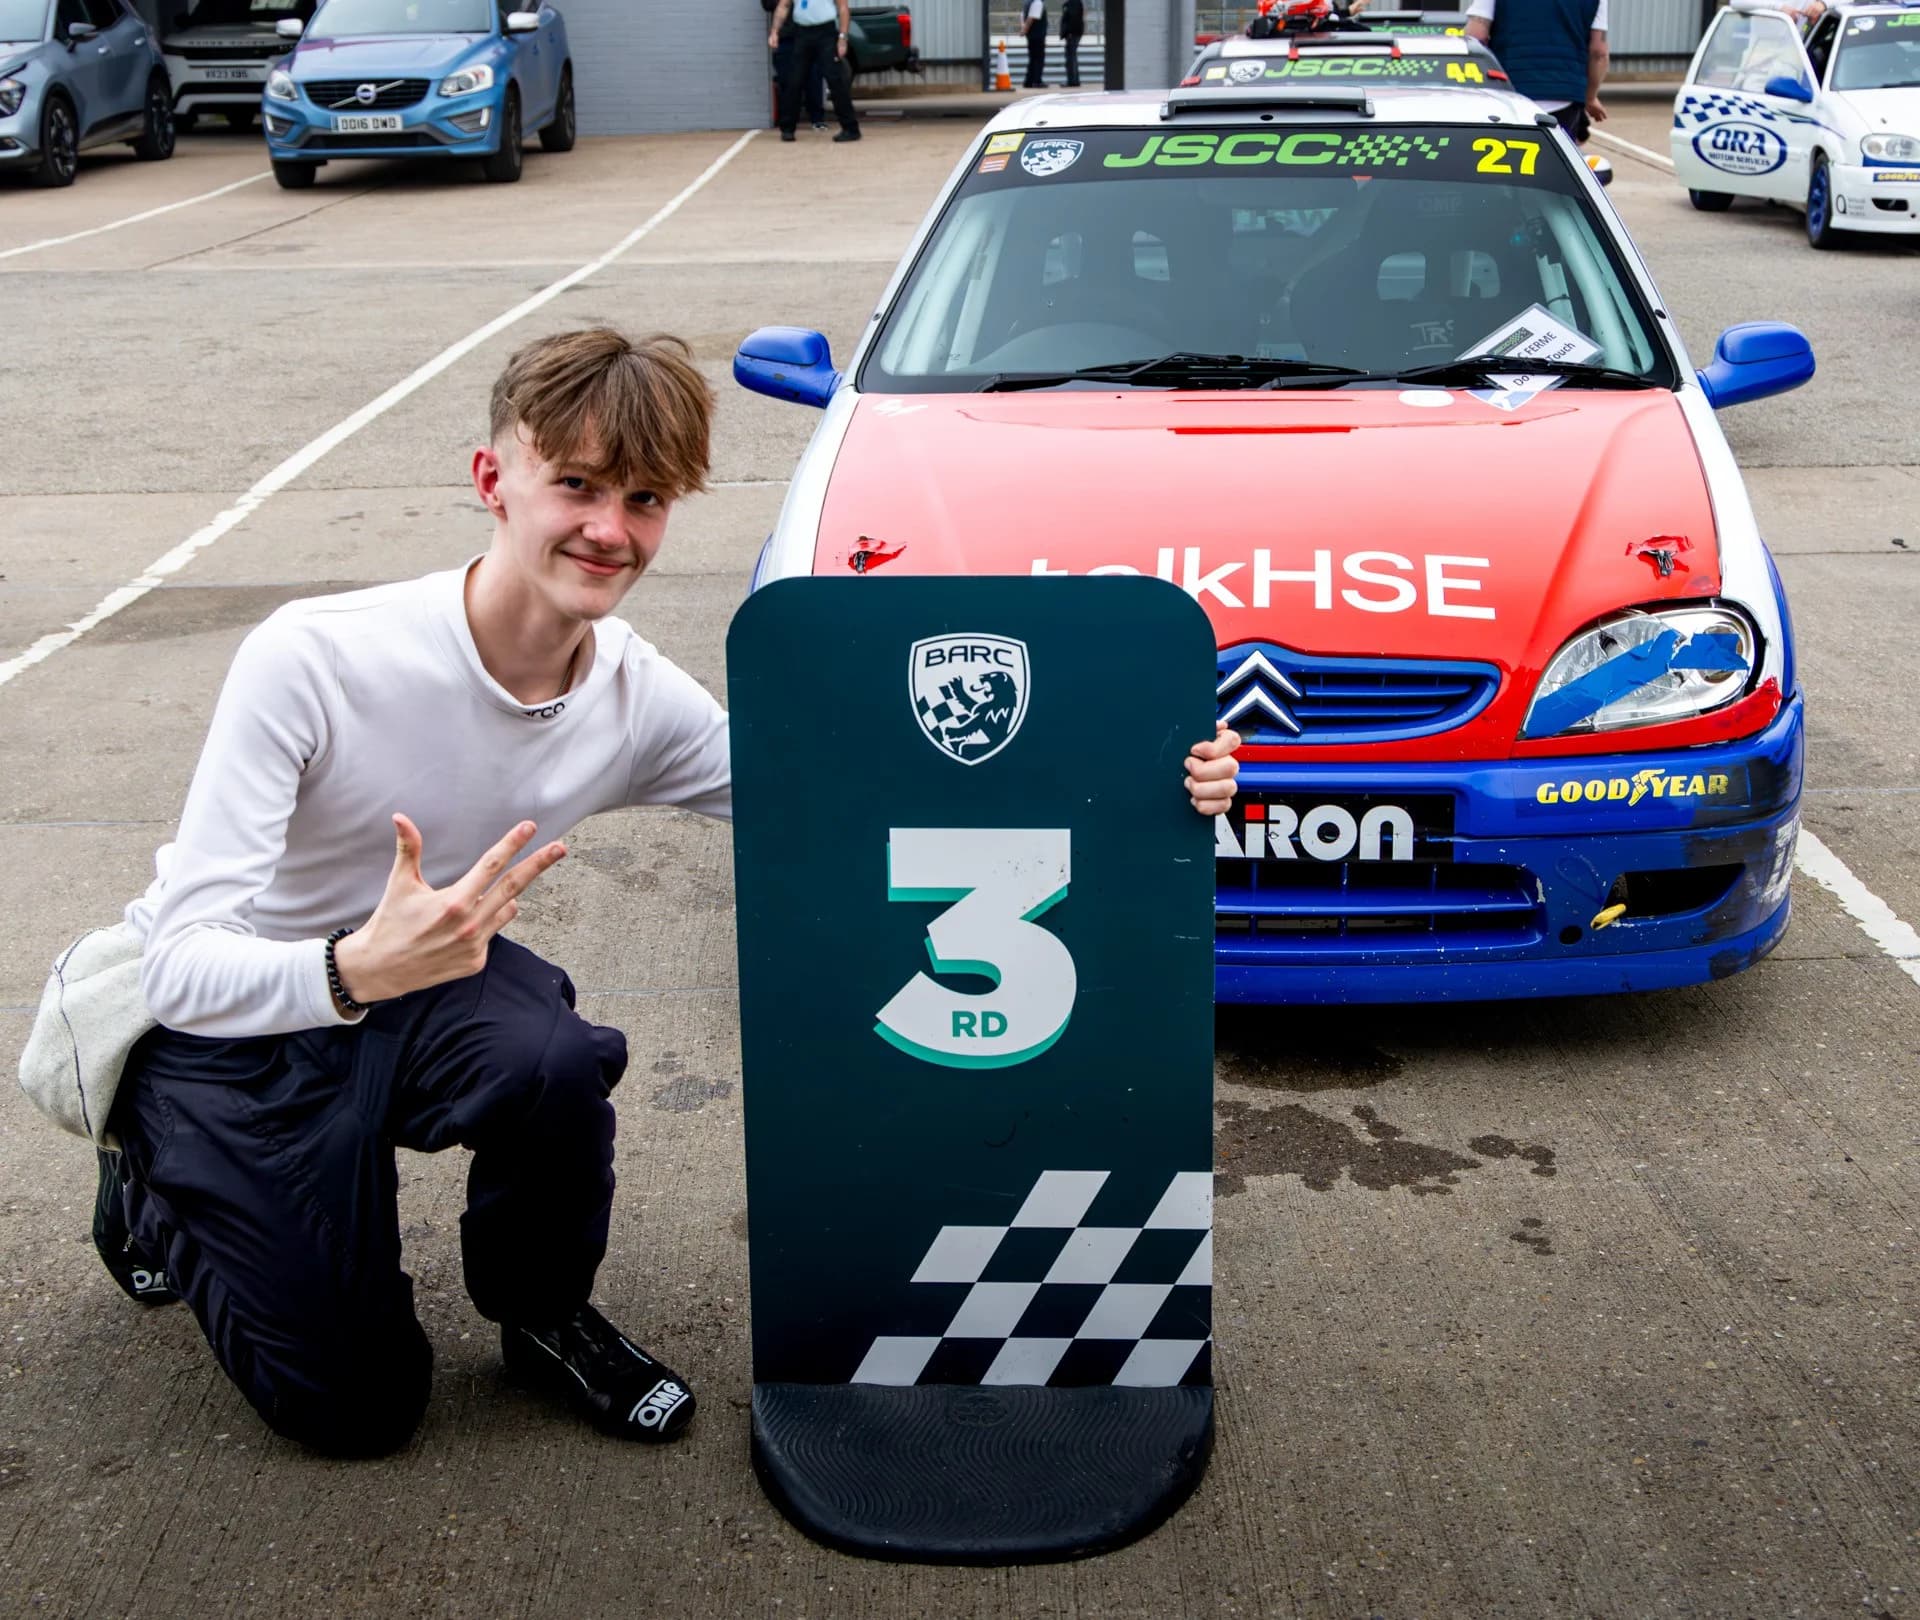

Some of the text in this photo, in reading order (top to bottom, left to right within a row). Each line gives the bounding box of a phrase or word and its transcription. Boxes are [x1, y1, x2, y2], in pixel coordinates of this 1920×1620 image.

[1264, 59, 1386, 78] JSCC
[1445, 62, 1484, 83] 44
[1031, 141, 1078, 149] BARC
[1103, 133, 1342, 168] JSCC
[1472, 138, 1541, 175] 27
[1524, 331, 1557, 355] FERME
[1513, 343, 1577, 386] Do Touch
[1031, 547, 1496, 620] lkHSE
[924, 645, 1015, 668] BARC
[873, 828, 1077, 1069] 3
[952, 1010, 1008, 1038] RD
[637, 1382, 685, 1427] OMP
